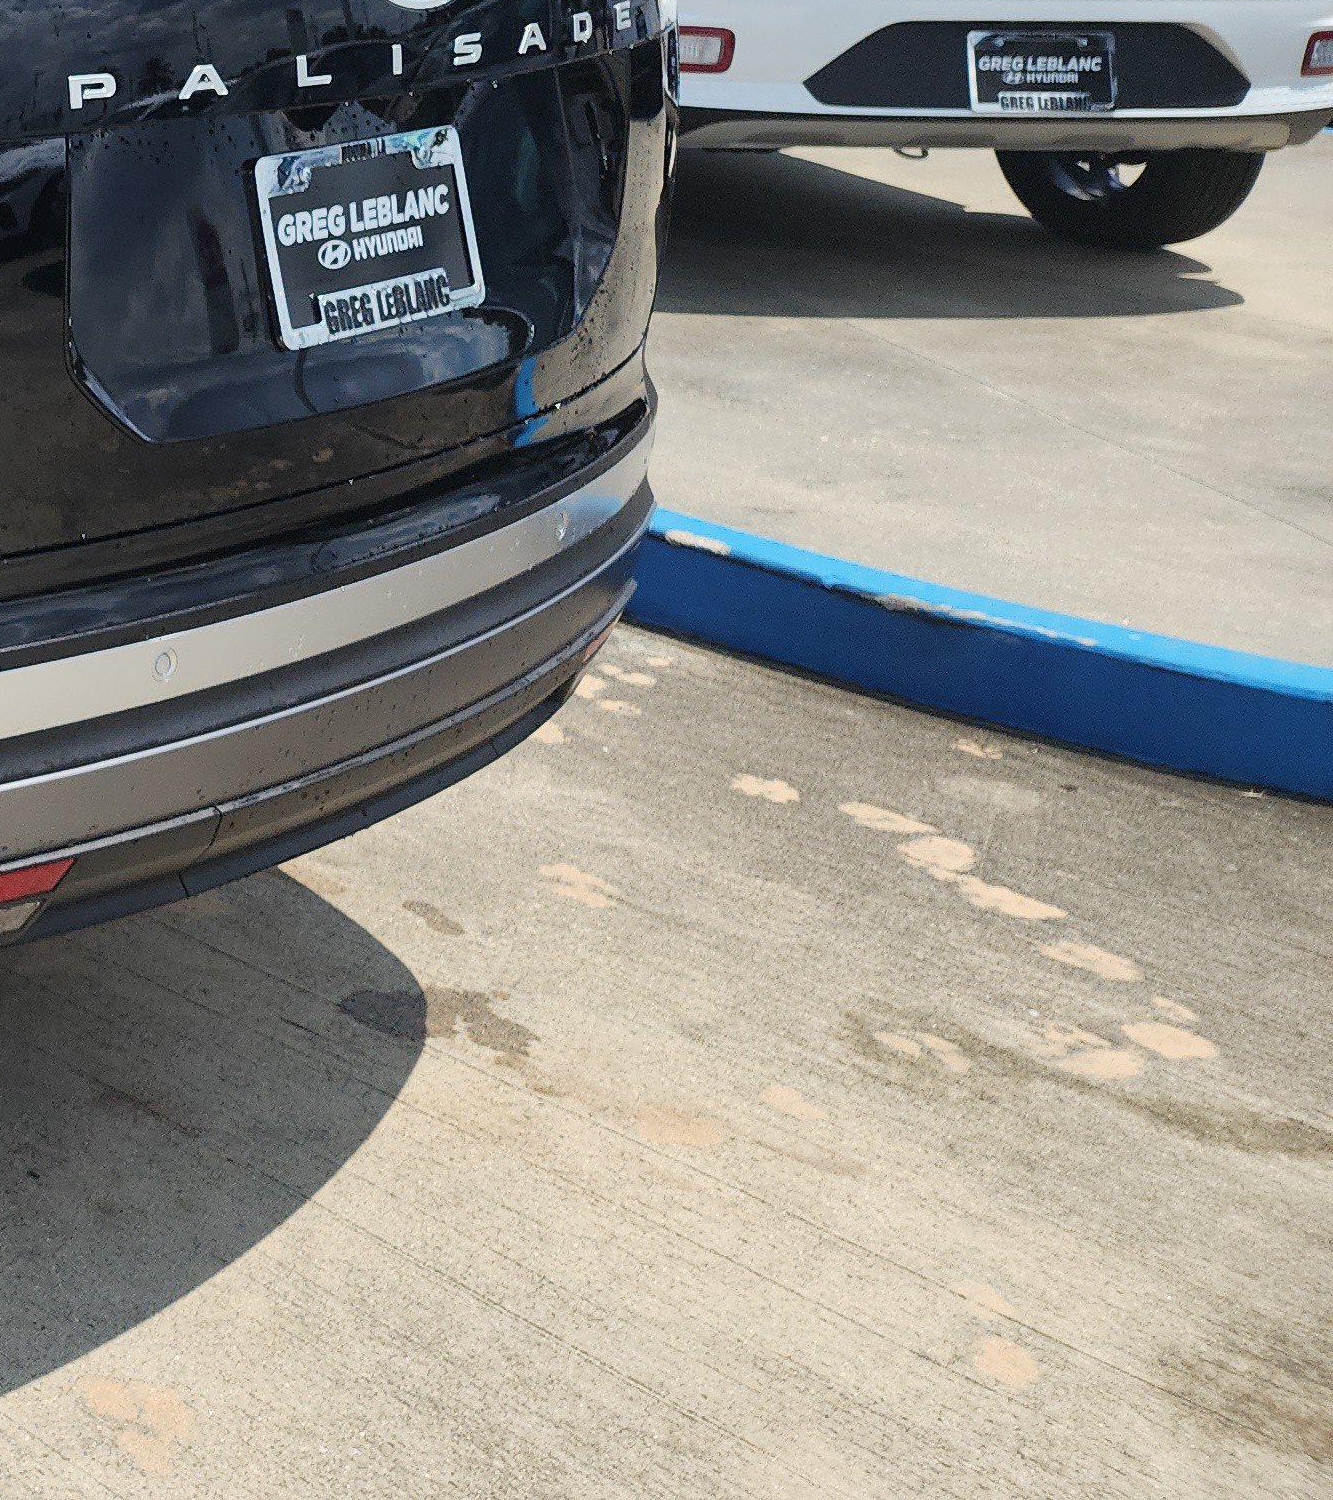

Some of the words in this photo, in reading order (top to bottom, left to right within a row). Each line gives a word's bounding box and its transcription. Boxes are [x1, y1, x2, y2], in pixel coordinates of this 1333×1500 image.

[68, 0, 633, 109] PALISADE
[978, 55, 1024, 71] GREG
[1026, 55, 1102, 72] LEBLANC
[1027, 72, 1078, 83] HYUNDAI
[1000, 96, 1035, 110] GREG
[278, 204, 346, 246] GREG
[349, 184, 450, 233] LEBLANC
[353, 226, 424, 261] HYUNDAI
[324, 293, 374, 334] GREG
[376, 275, 451, 322] LEBLANC
